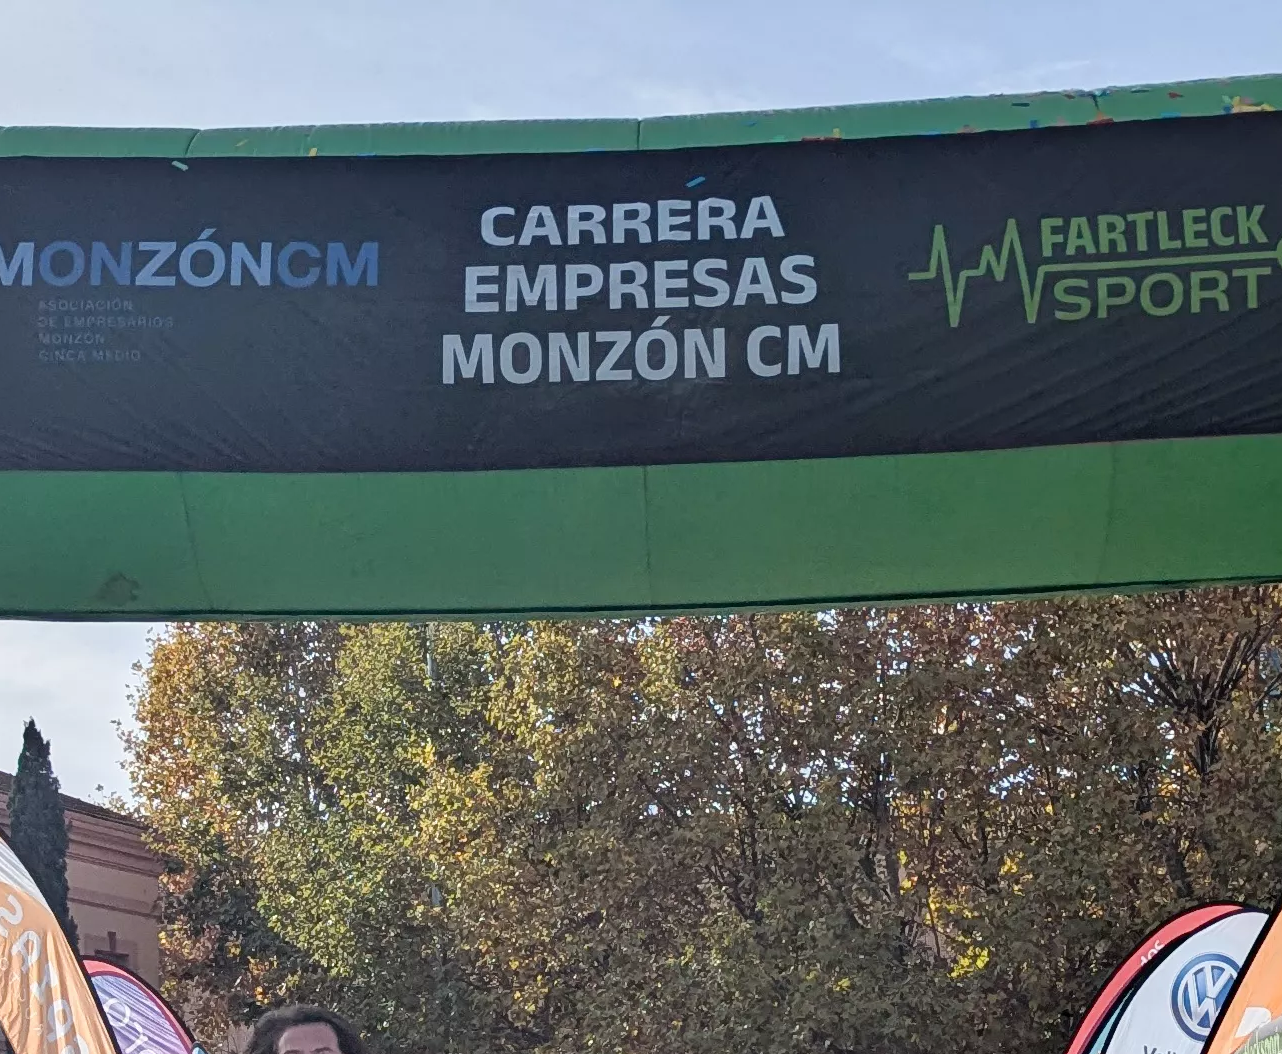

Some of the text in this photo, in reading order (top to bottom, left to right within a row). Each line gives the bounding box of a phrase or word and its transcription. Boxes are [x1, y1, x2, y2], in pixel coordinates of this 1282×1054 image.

[481, 195, 784, 247] CARRERA
[1041, 204, 1269, 257] FARTLECK
[464, 254, 818, 314] EMPRESAS
[1053, 265, 1273, 322] SPORT
[442, 316, 841, 384] MONZÓN CM
